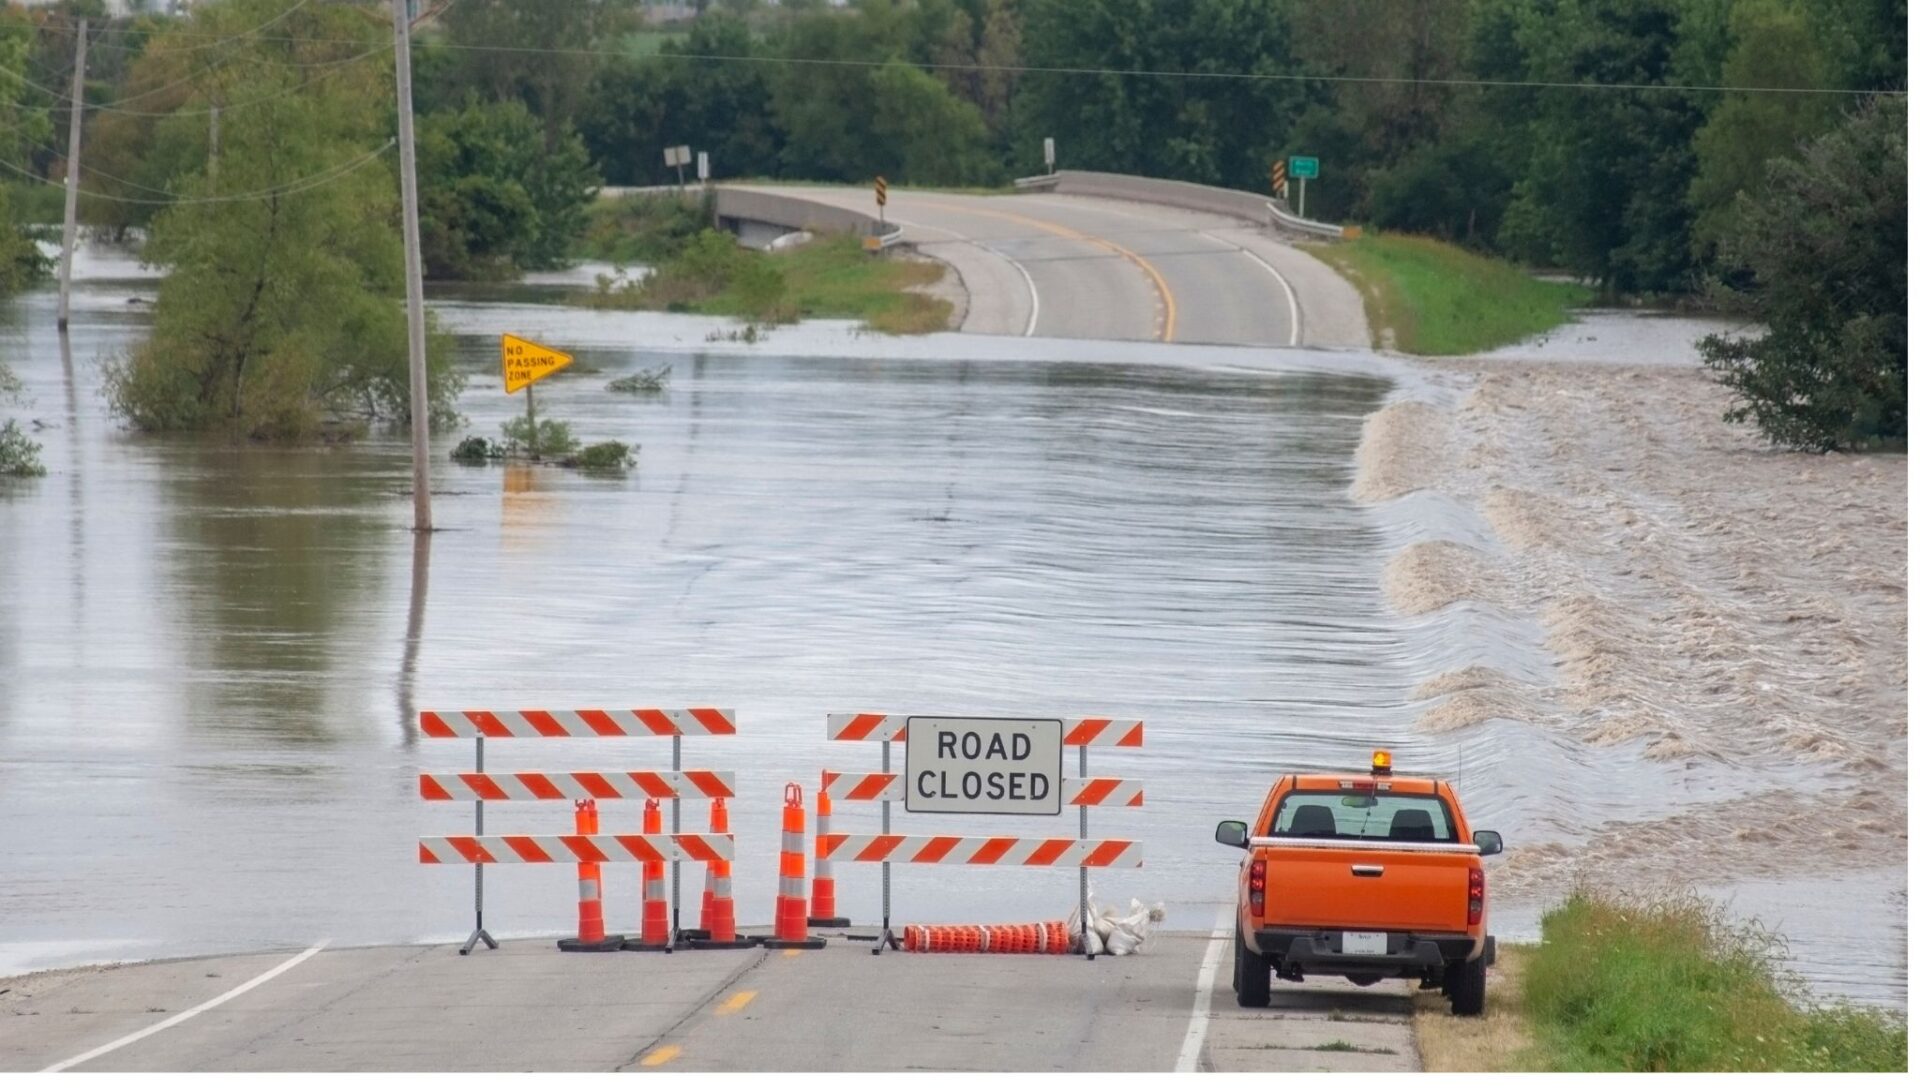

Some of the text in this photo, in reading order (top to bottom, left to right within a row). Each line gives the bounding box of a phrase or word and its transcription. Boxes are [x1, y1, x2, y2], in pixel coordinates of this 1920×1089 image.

[506, 346, 523, 356] NO
[507, 356, 555, 368] PASSING
[508, 370, 531, 381] ZONE
[938, 731, 1031, 761] ROAD
[917, 770, 1049, 800] CLOSED
